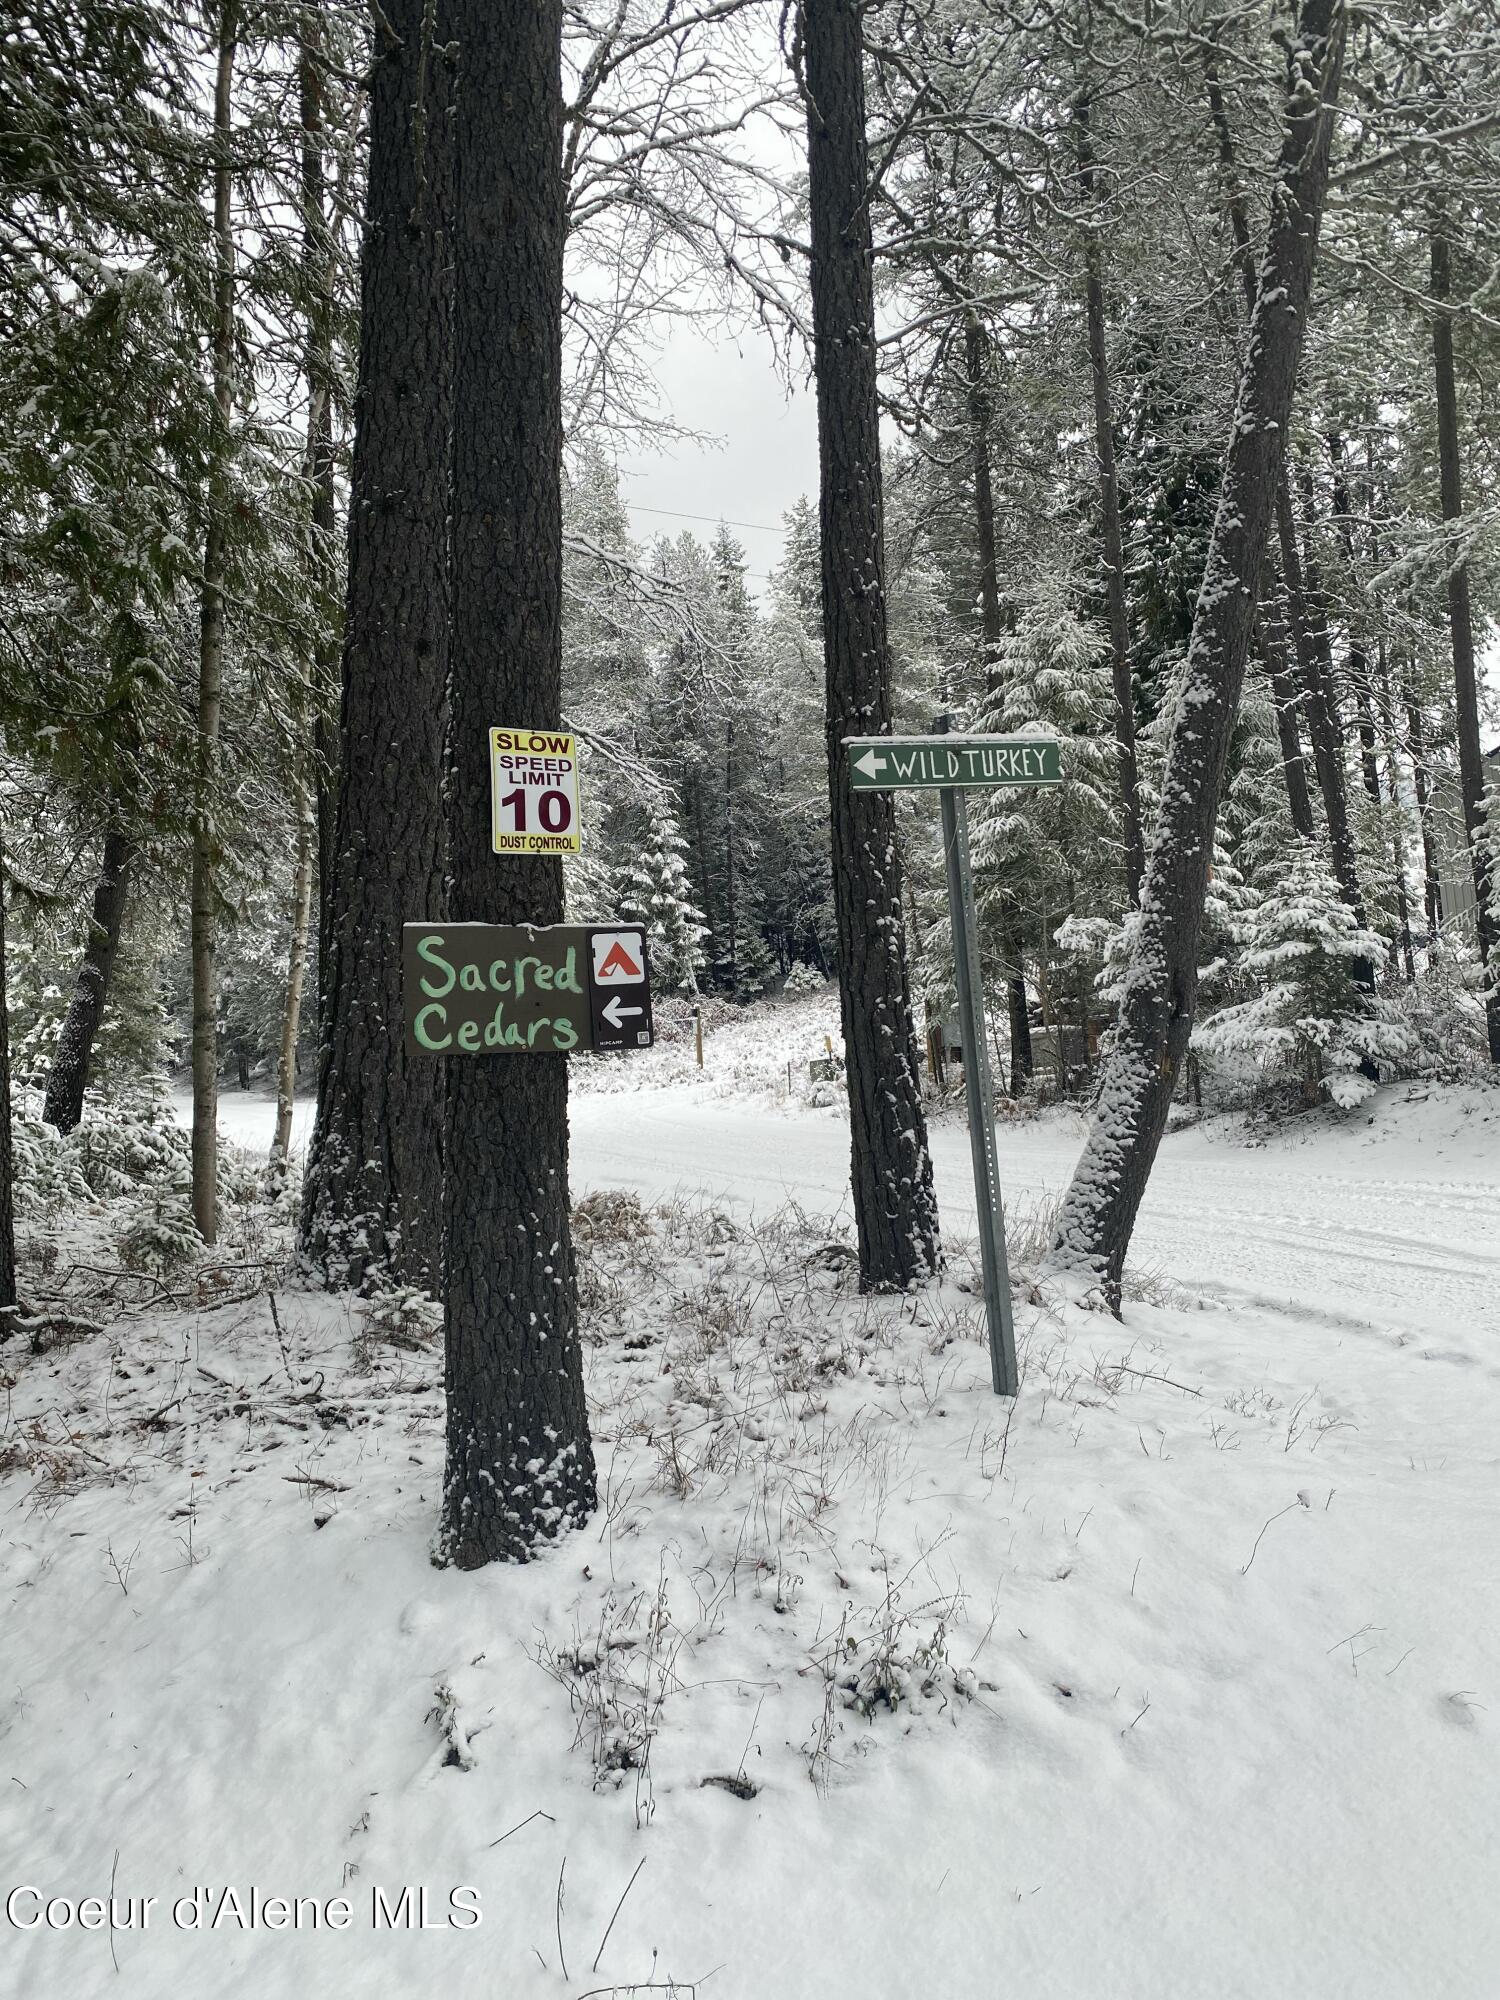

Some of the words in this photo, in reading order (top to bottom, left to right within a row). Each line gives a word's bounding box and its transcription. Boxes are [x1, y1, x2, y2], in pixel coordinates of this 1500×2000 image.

[496, 733, 570, 754] SLOW
[500, 755, 572, 772] SPEED
[891, 750, 959, 779] WILD
[961, 748, 1047, 778] TURKEY
[508, 771, 565, 787] LIMIT
[501, 788, 572, 834] 10
[500, 836, 527, 849] DUST
[529, 836, 575, 850] CONTROL
[416, 935, 584, 1000] Sacred
[413, 1001, 579, 1051] Cedars
